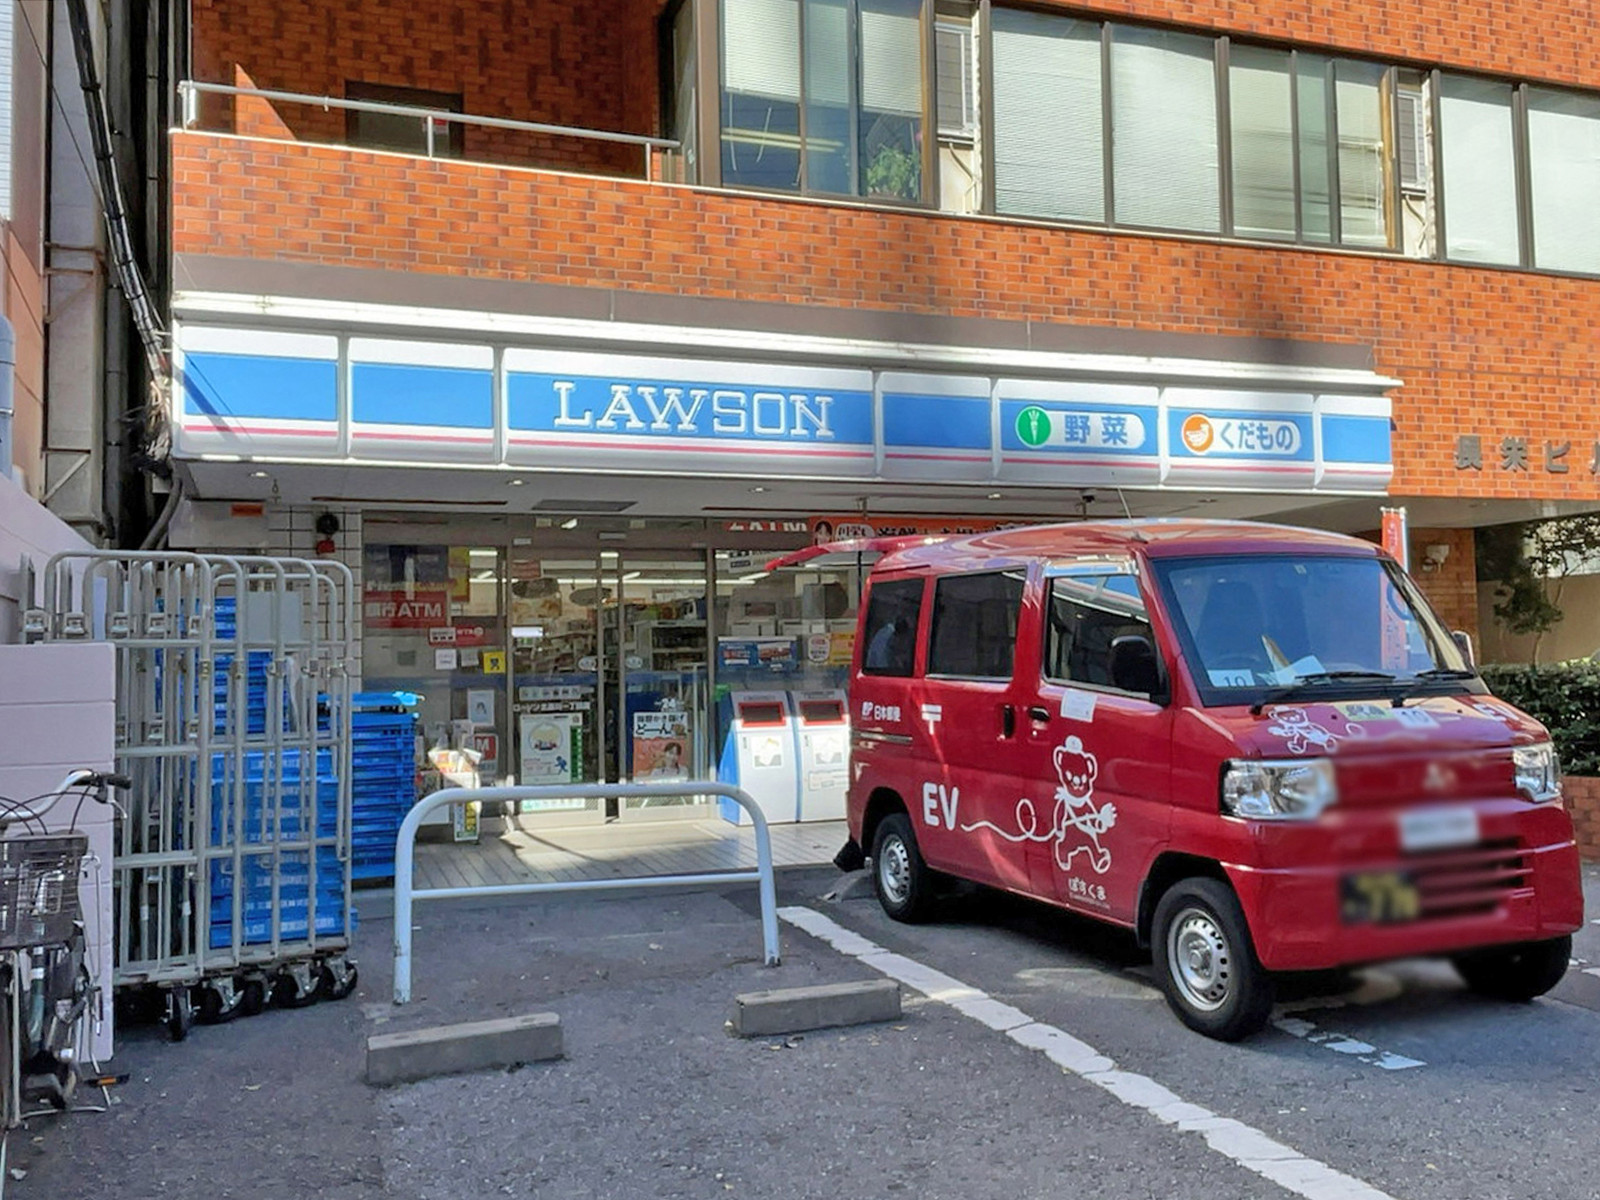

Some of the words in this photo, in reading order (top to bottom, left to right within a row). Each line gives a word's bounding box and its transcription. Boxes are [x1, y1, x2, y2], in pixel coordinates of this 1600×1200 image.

[553, 381, 834, 438] LAWSON
[1064, 414, 1128, 445] 野菜
[1220, 421, 1294, 450] くだもの
[922, 781, 960, 831] EV
